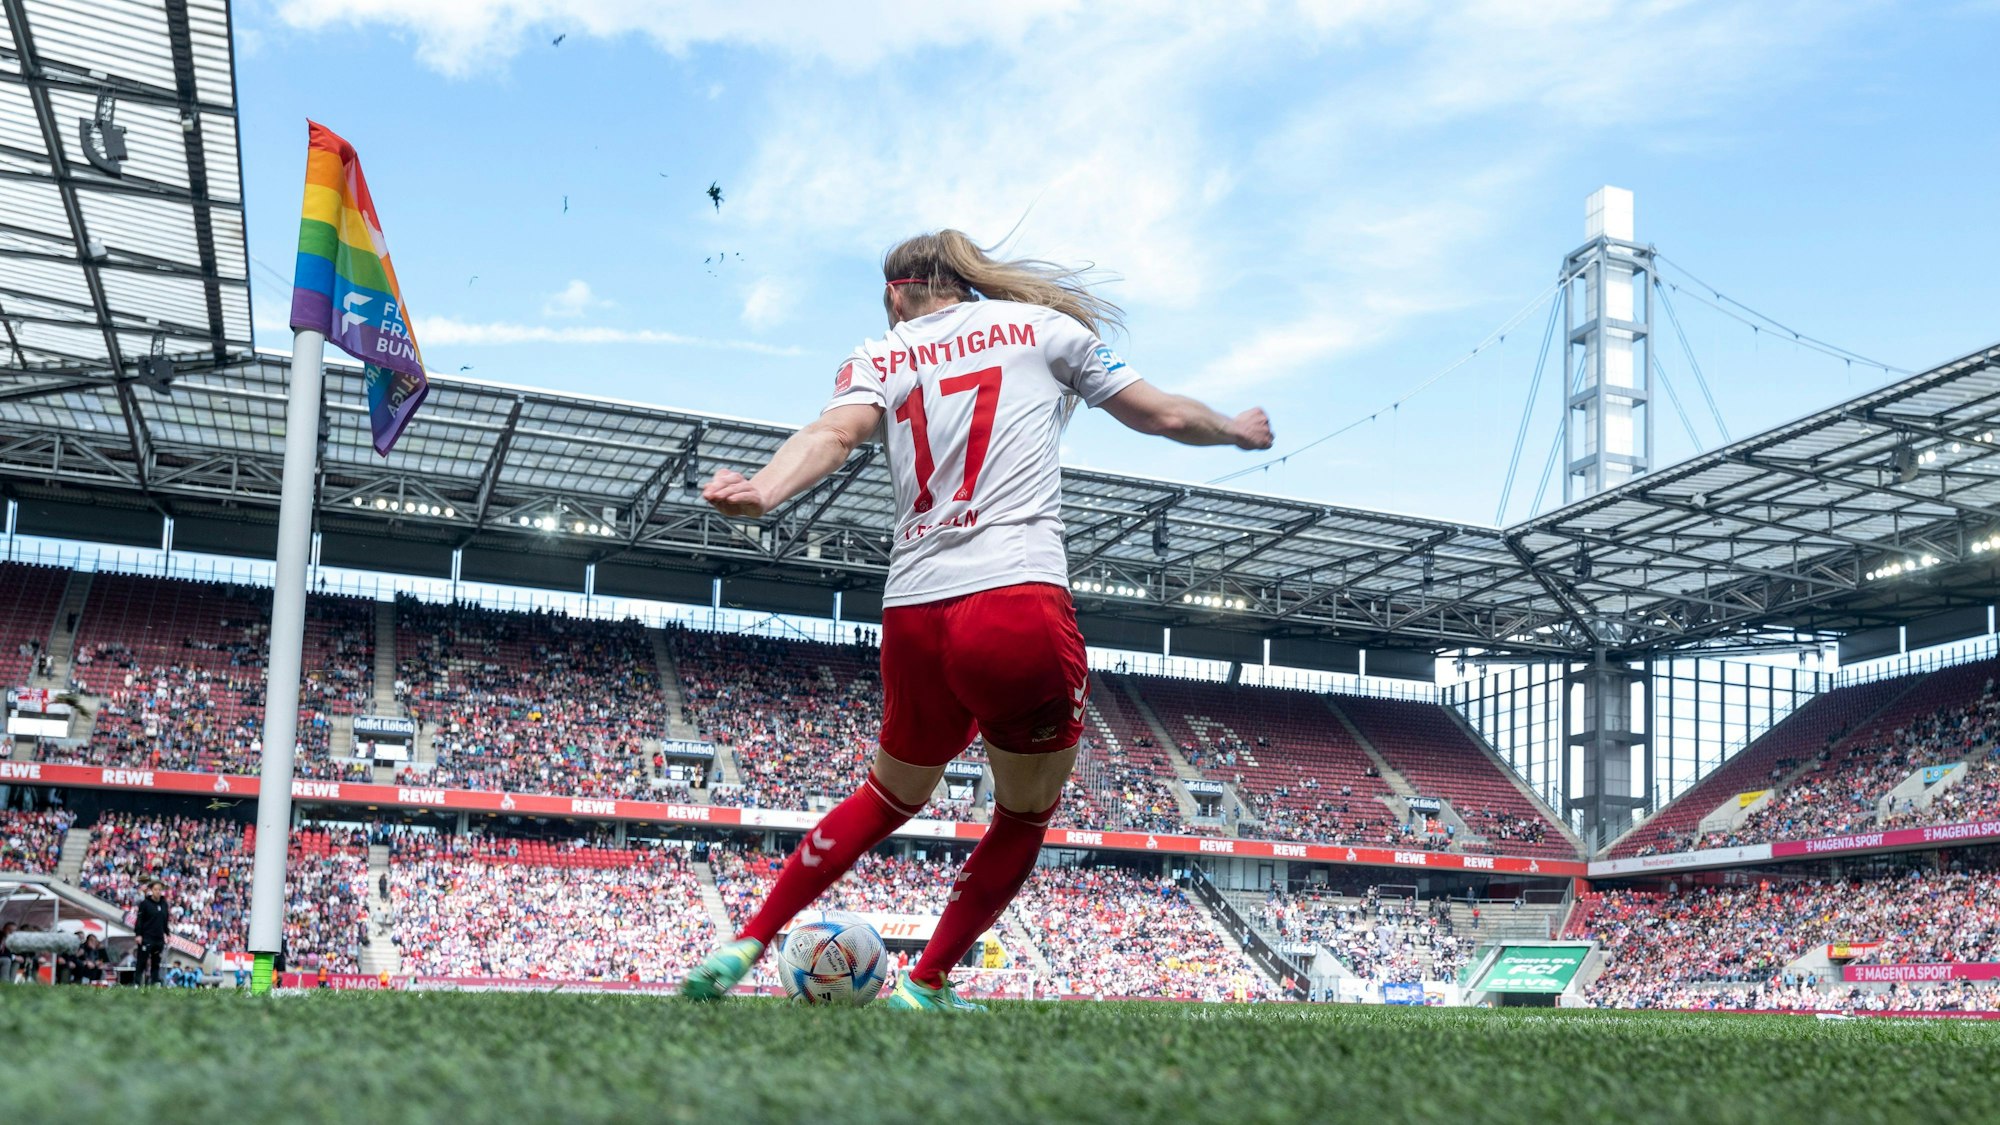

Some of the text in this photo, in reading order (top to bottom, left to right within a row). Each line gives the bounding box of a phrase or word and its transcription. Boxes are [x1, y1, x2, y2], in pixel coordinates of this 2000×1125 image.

[896, 366, 1003, 513] 17
[102, 769, 445, 804] REWE REWE REWE
[571, 799, 710, 820] REWE REWE
[1932, 824, 1980, 840] MAGENTA
[1981, 821, 2000, 835] SPO
[1066, 831, 1494, 869] REWE REWE REWE REWE REWE
[1813, 837, 1855, 852] MAGENTA
[1855, 833, 1884, 848] SPORT
[880, 923, 921, 936] HIT
[1489, 978, 1559, 987] DEVK
[1865, 966, 1916, 980] MAGENTA
[1917, 966, 1953, 979] SPORT
[345, 978, 411, 989] MAGTA
